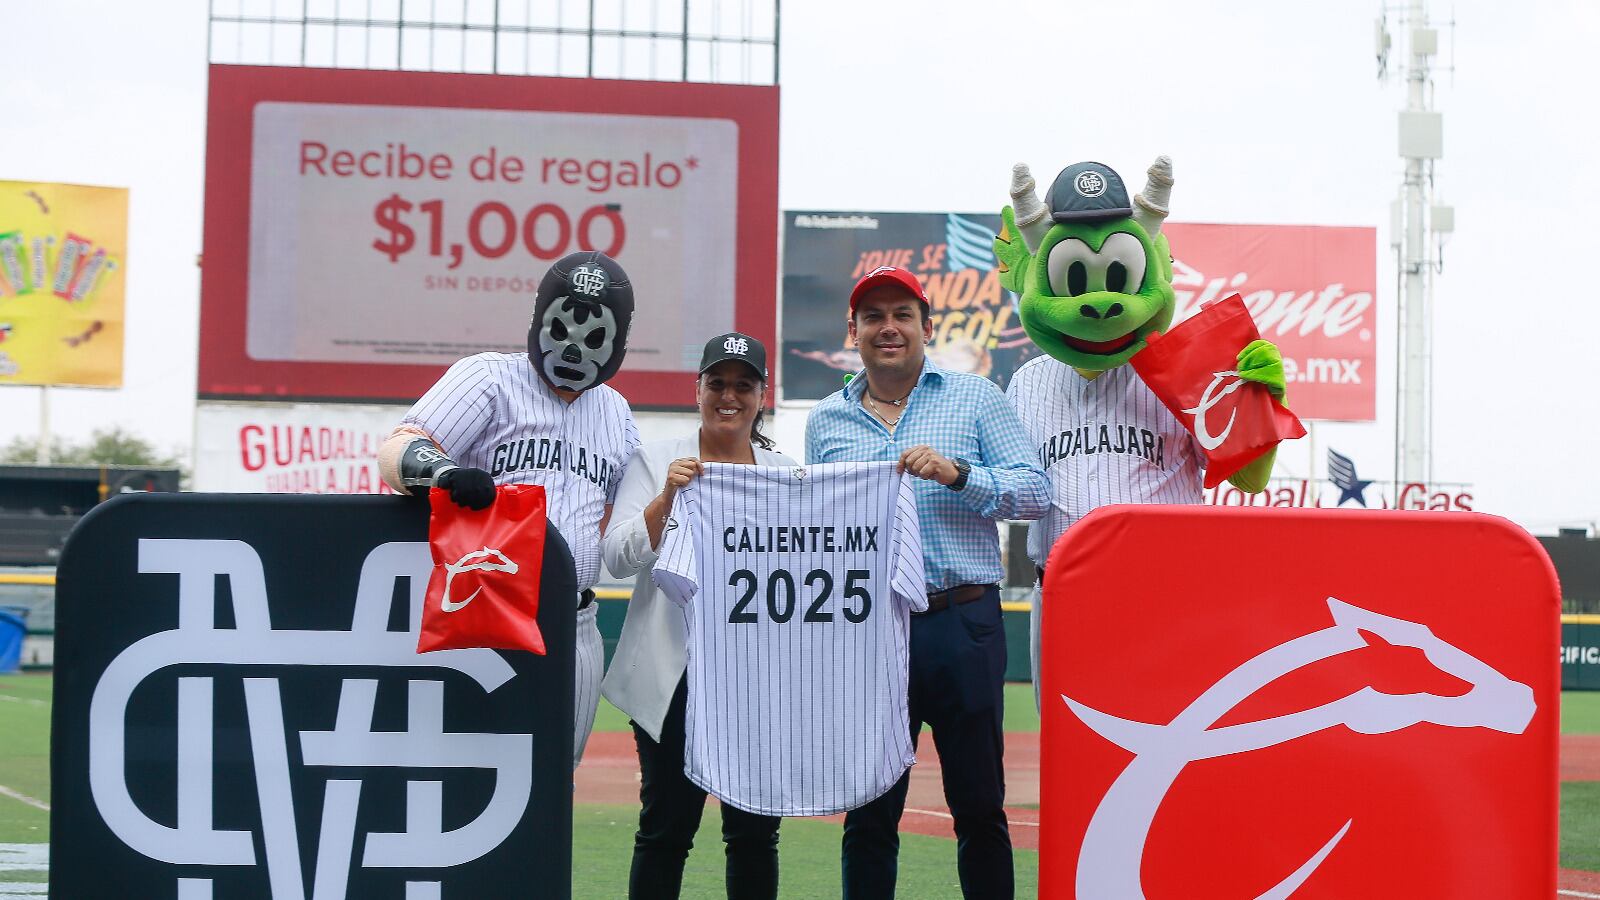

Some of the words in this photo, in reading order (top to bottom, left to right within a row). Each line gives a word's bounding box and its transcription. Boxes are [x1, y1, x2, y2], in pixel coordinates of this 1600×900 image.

[299, 141, 453, 181] Recibe
[469, 147, 524, 183] de
[372, 194, 627, 269] $1,000
[918, 242, 948, 272] SE
[424, 275, 459, 290] SIN
[1399, 483, 1474, 511] Gas
[723, 525, 879, 553] CALIENTE.MX
[728, 568, 873, 624] 2025
